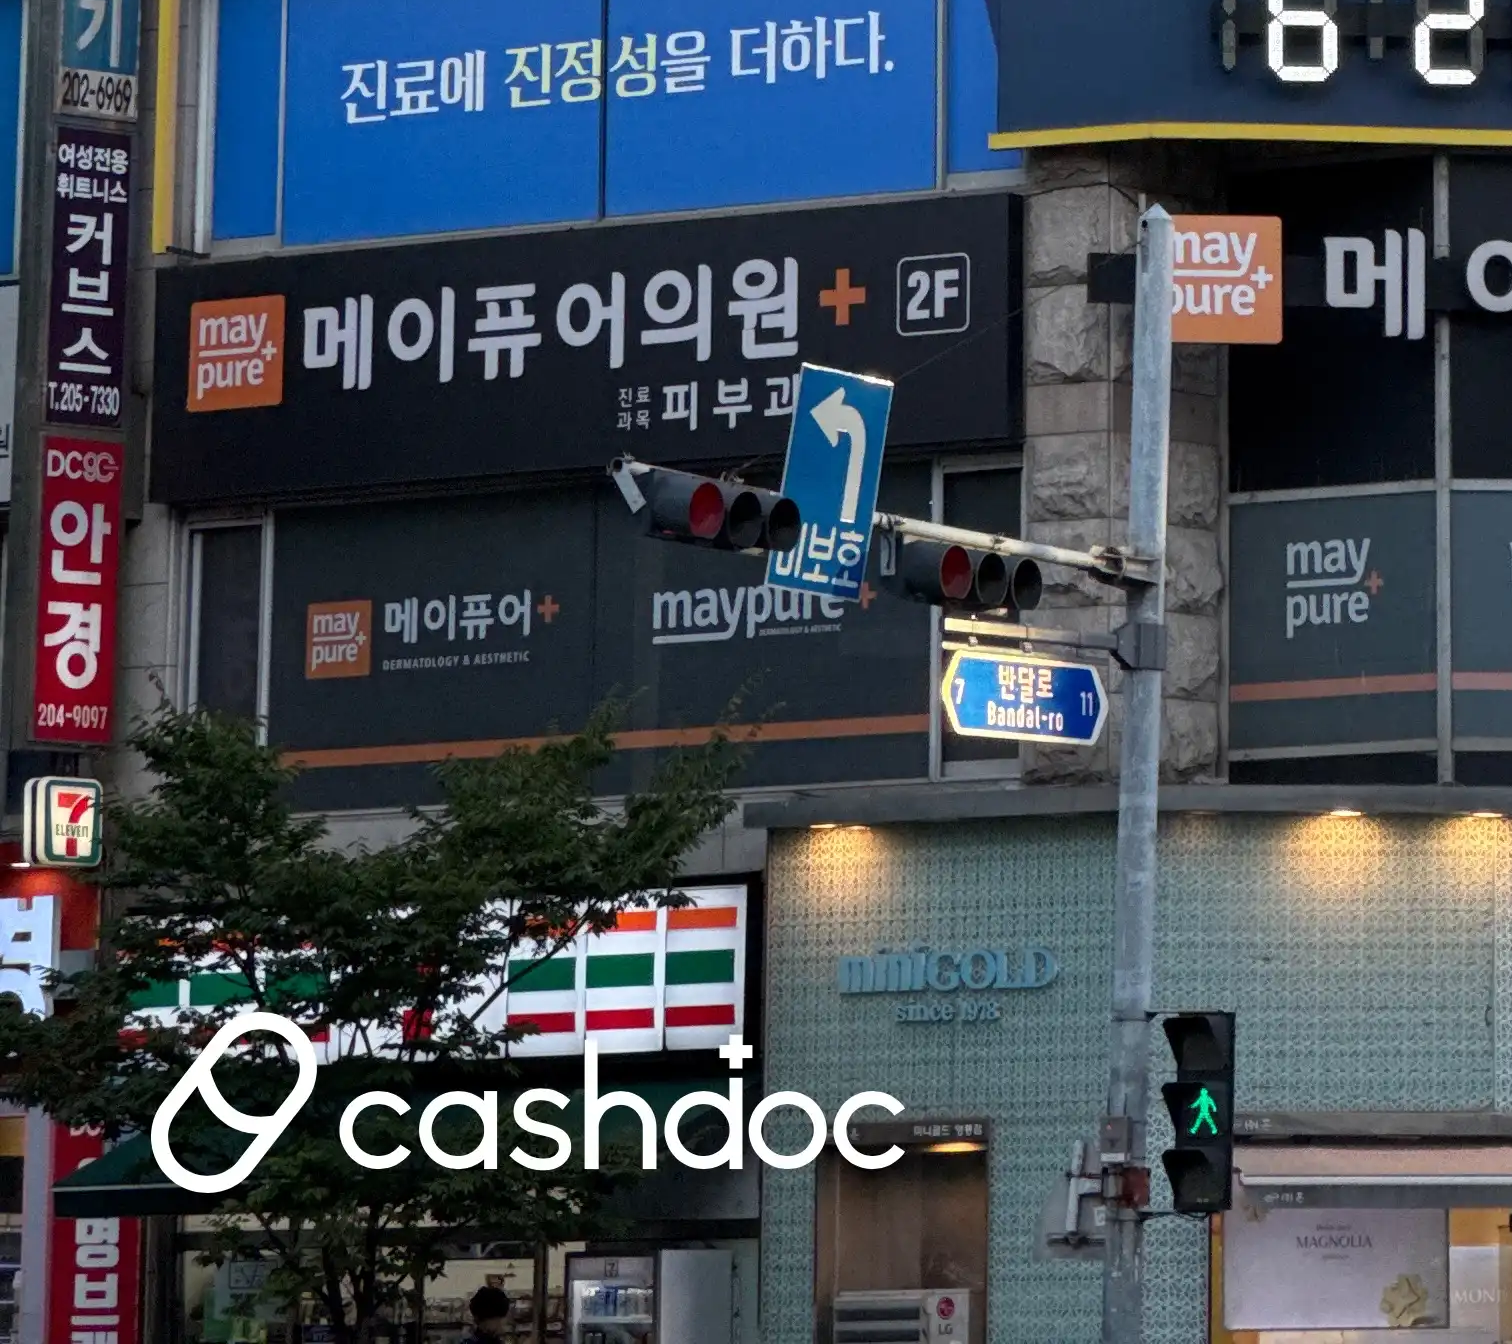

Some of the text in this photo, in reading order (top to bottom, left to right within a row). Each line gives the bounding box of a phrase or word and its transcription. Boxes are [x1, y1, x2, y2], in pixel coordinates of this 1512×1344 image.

[340, 10, 896, 125] 진료에 진정성을 더하다.
[60, 69, 133, 115] 202-6969
[56, 142, 129, 176] 여성전용
[55, 172, 129, 206] 휘트니스
[57, 211, 116, 377] 커브스
[198, 311, 269, 349] may
[303, 255, 961, 392] 메이퓨어의원 2F
[196, 356, 265, 400] pure
[47, 380, 121, 418] T.205-7330
[1285, 537, 1372, 591] may
[44, 500, 113, 691] 안경
[311, 608, 361, 640] may
[383, 588, 533, 645] 메이퓨어
[1284, 593, 1371, 640] pure
[309, 640, 358, 672] pure
[382, 653, 460, 672] DERMATOLOGY
[473, 649, 531, 667] AESTHETIC
[954, 663, 1096, 716] 7 반달로 11
[37, 703, 109, 730] 204-9097
[986, 699, 1066, 734] Bandal-ro
[1295, 1234, 1373, 1250] MAGNOLIA
